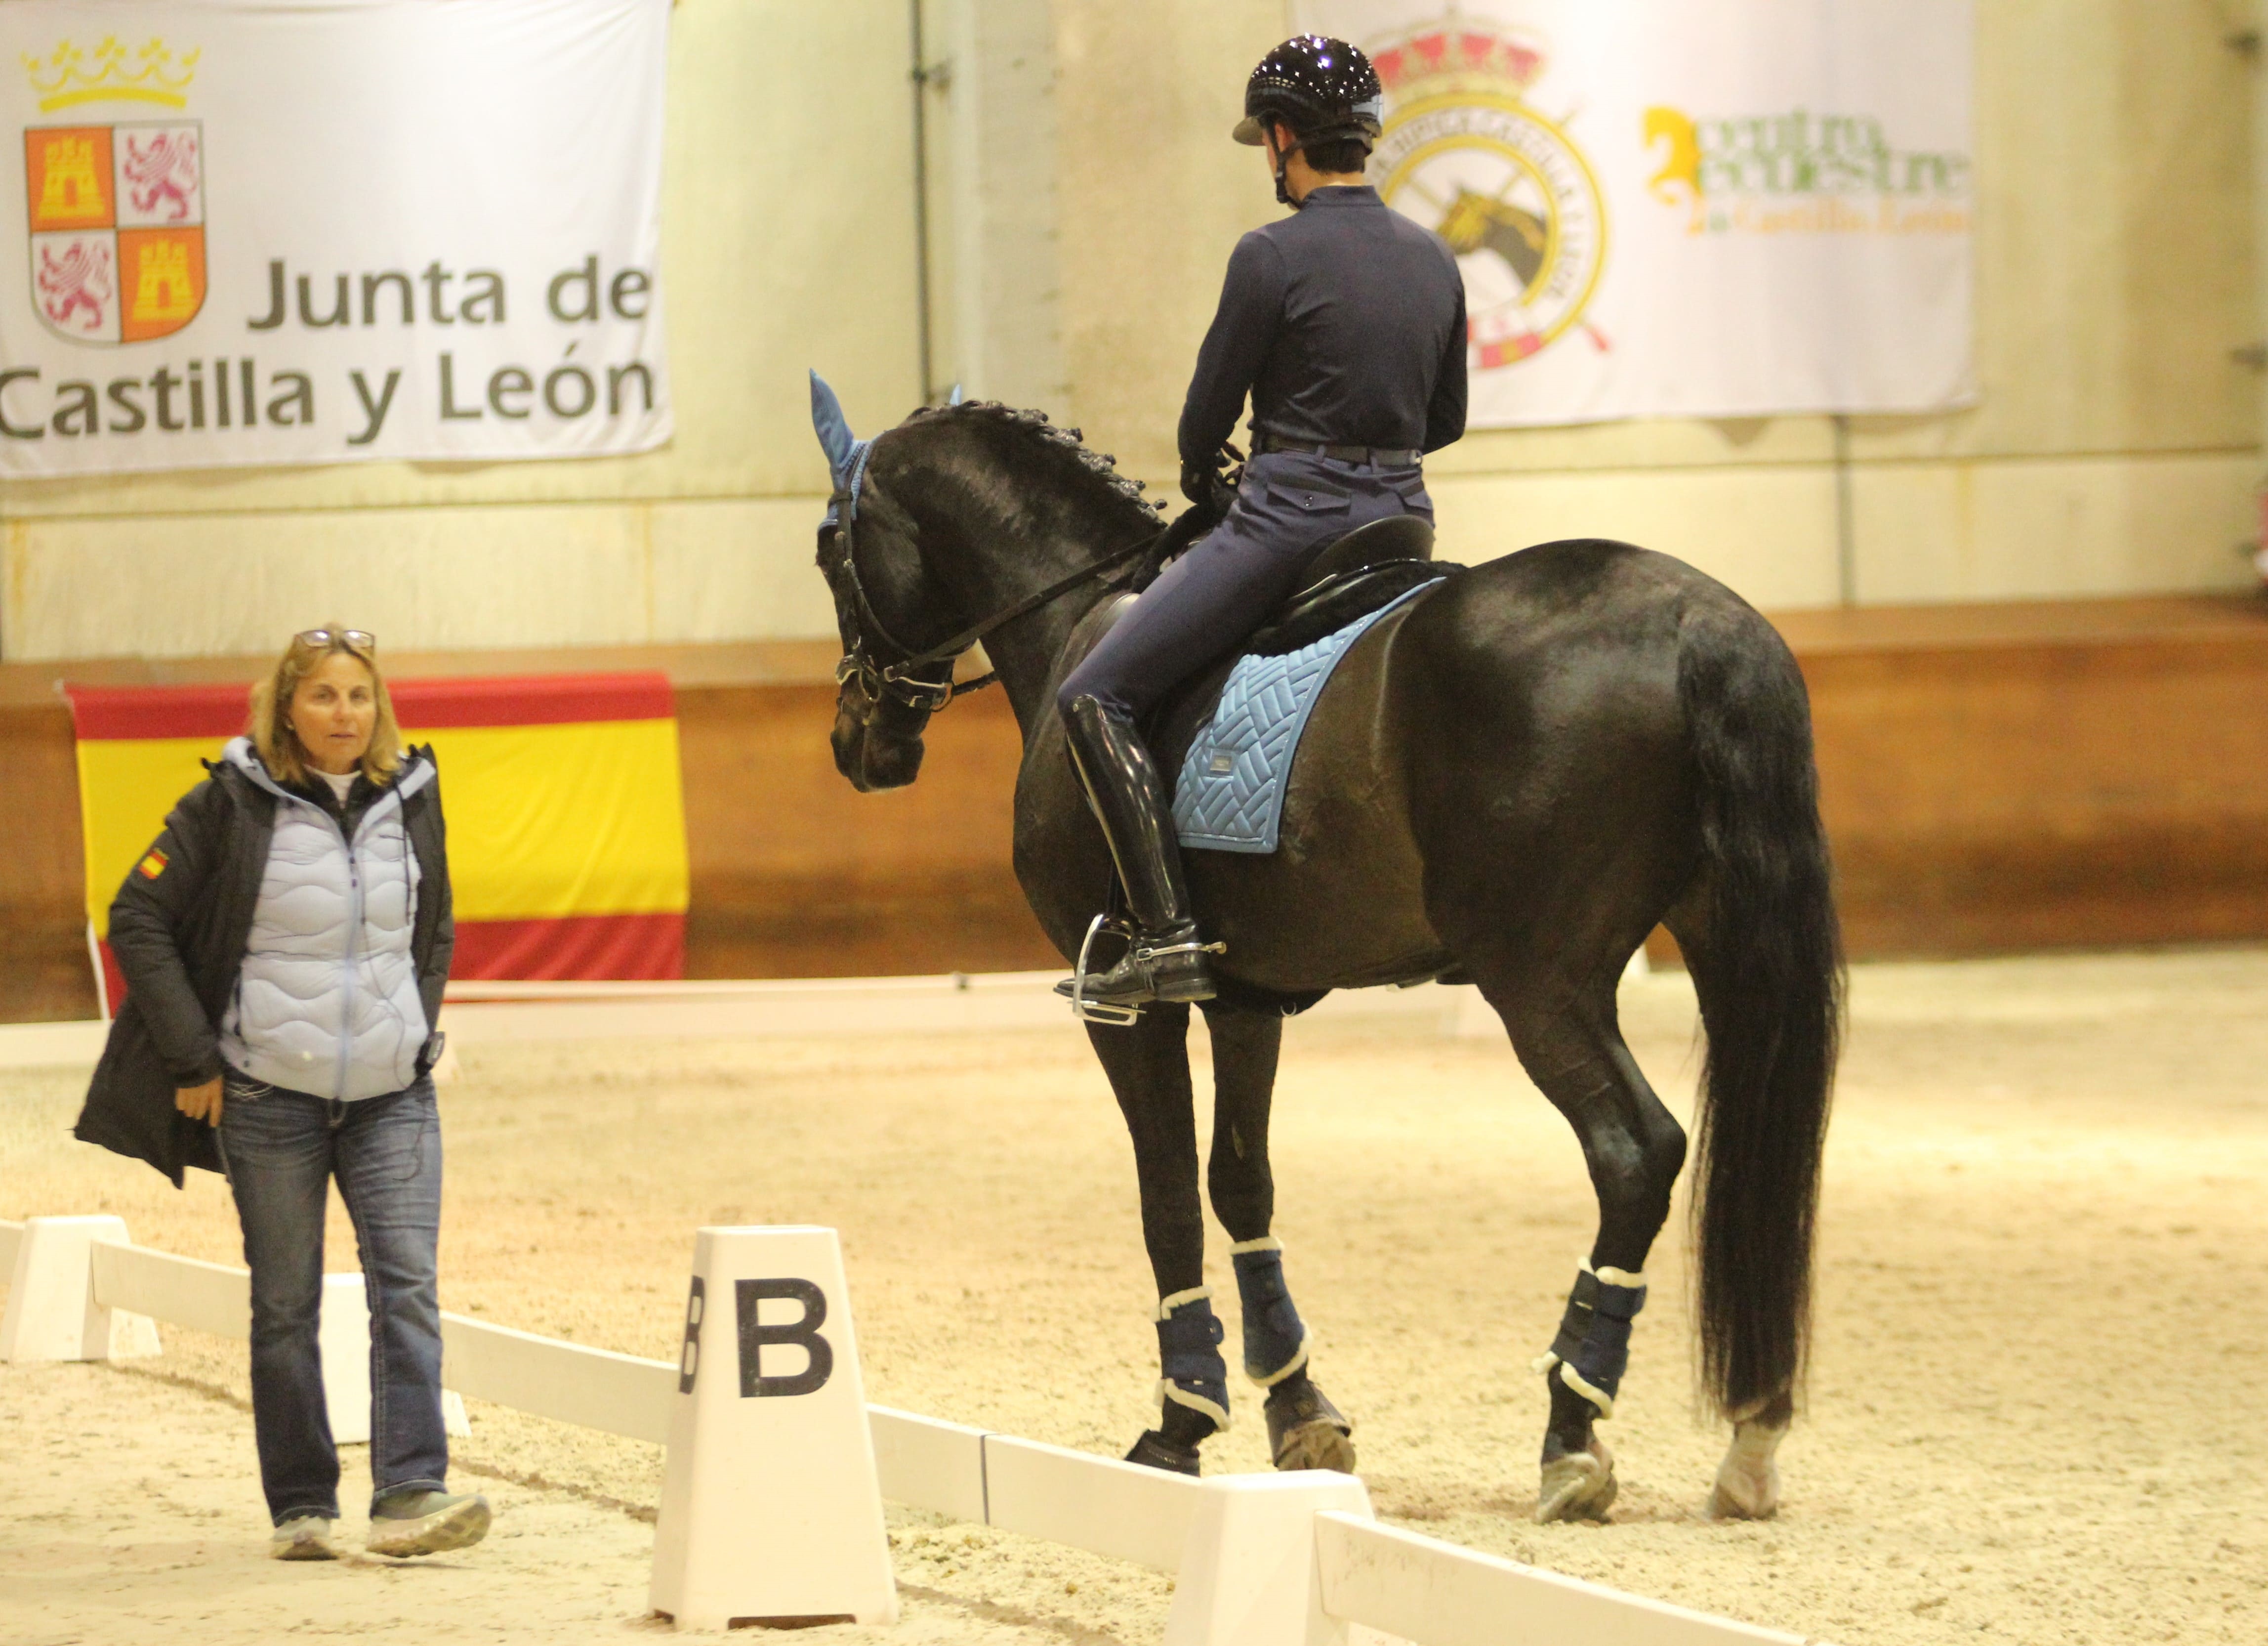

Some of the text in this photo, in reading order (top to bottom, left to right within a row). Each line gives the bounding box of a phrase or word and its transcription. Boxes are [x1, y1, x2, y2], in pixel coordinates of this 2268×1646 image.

[247, 255, 651, 333] Junta de
[0, 342, 654, 446] Castilla y León
[734, 1277, 834, 1398] B
